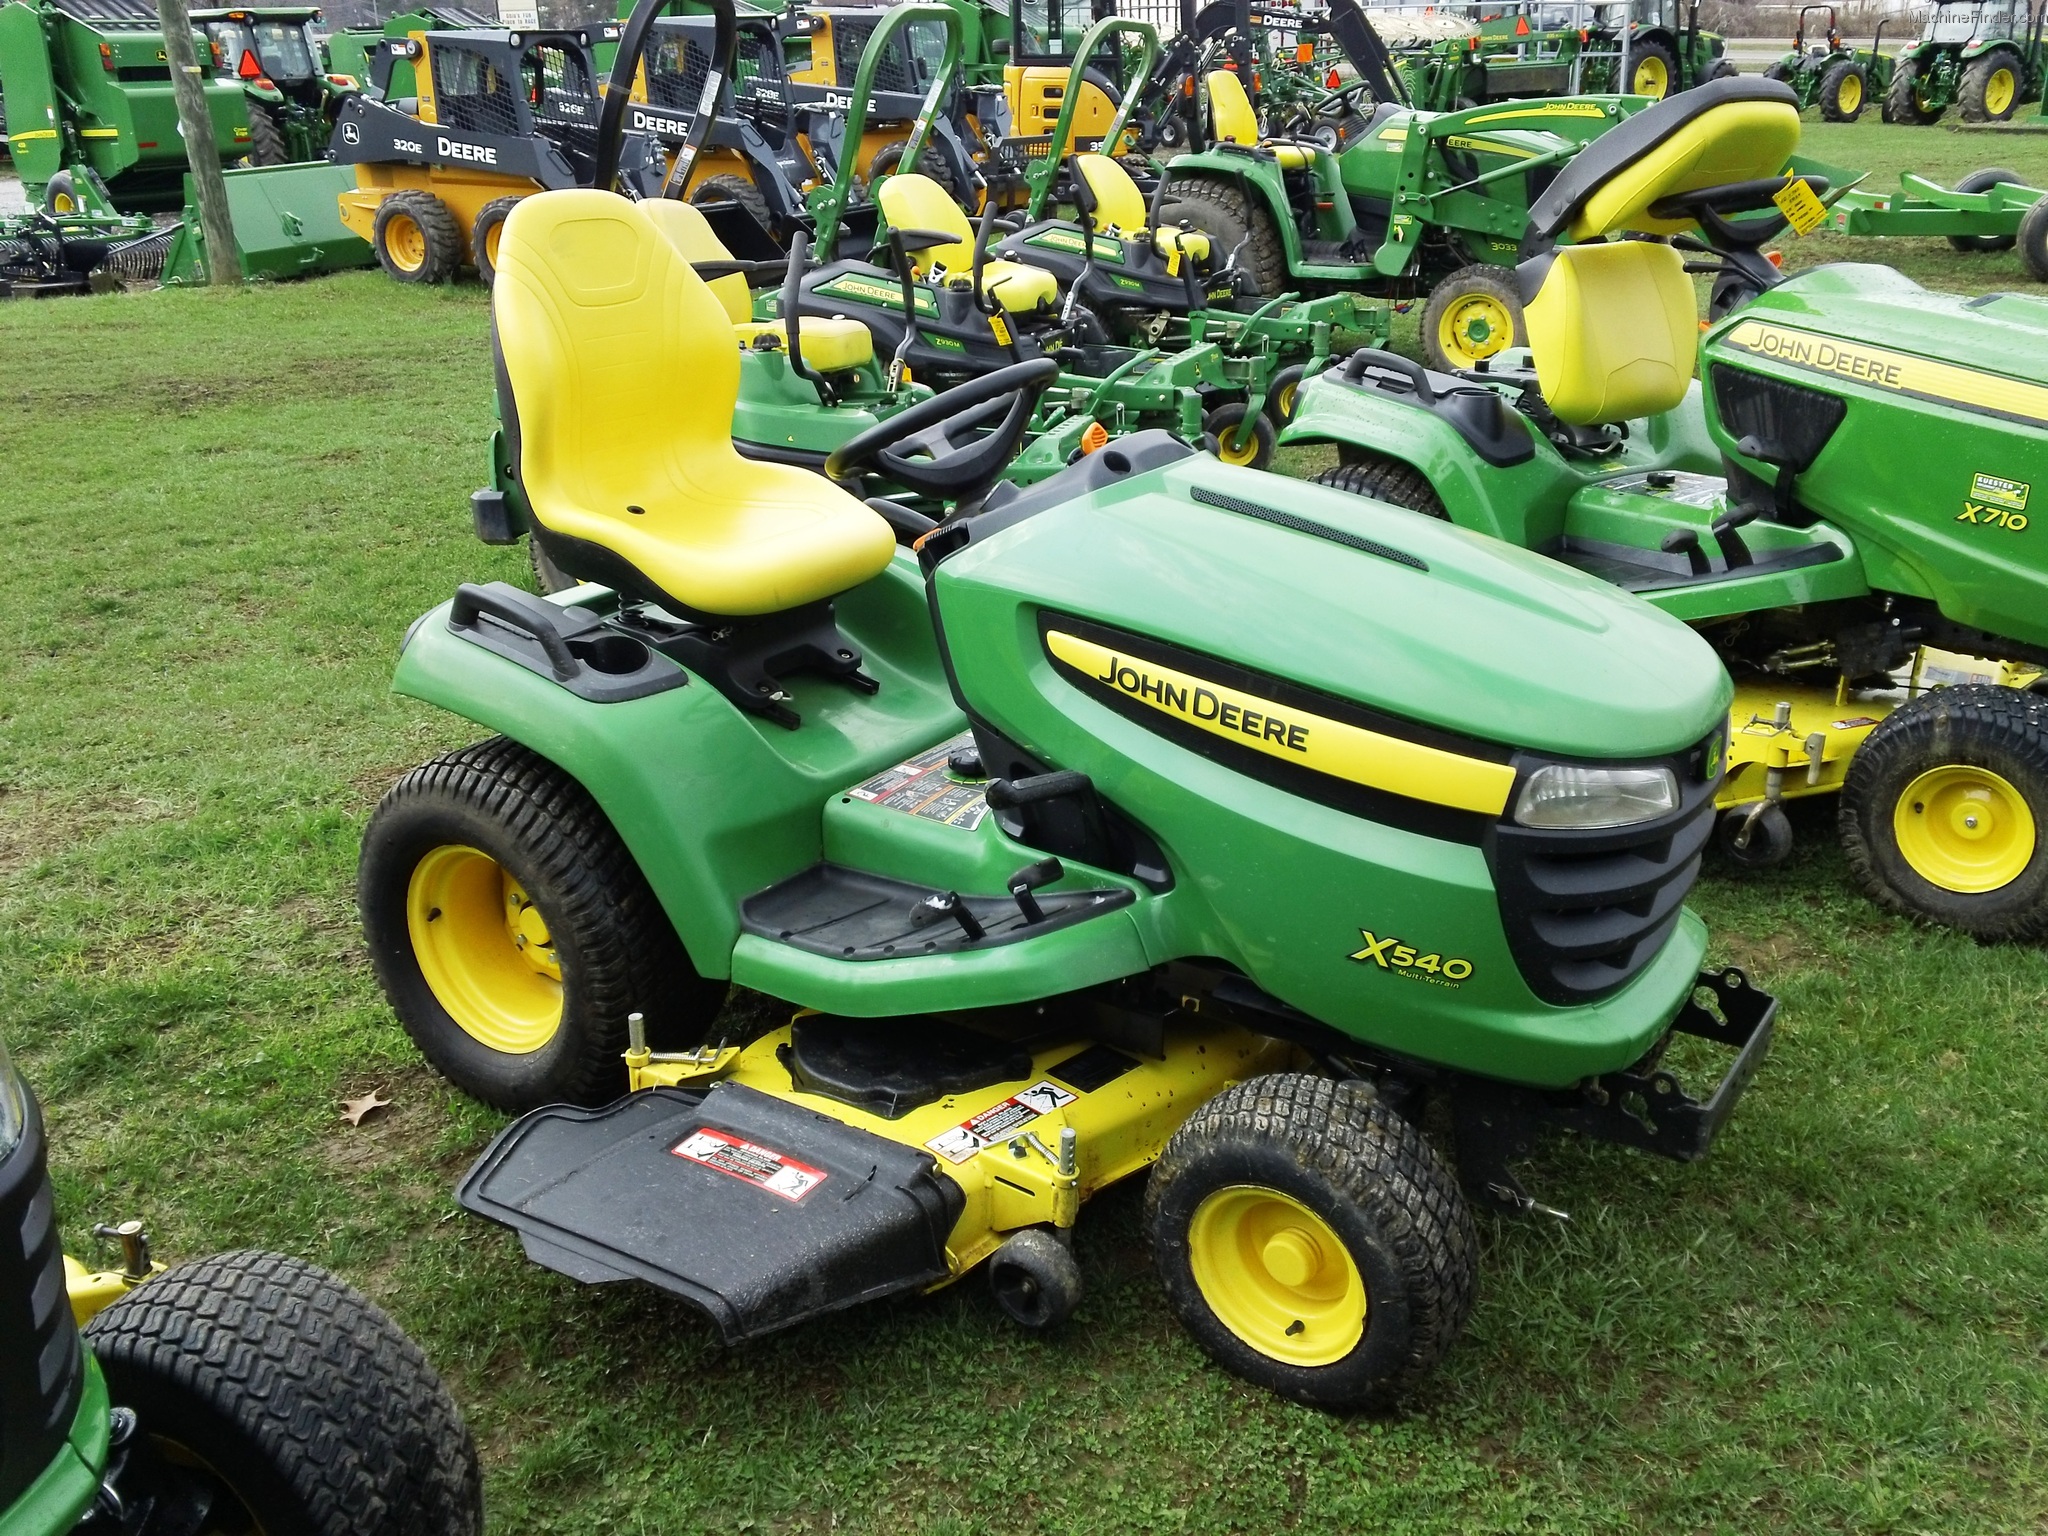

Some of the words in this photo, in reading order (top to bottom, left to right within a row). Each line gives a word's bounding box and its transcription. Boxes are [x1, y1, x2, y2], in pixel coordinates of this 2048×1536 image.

[1263, 14, 1303, 28] DEERE
[825, 91, 877, 113] DEEE
[1567, 103, 1597, 111] DEERE
[633, 111, 688, 137] DEERE
[393, 138, 423, 154] 320E
[437, 136, 497, 165] DEERE
[1449, 138, 1472, 148] EERE
[1049, 235, 1068, 245] JOHN
[842, 282, 866, 293] JOHN
[867, 286, 896, 299] DEERE
[1750, 327, 1813, 363] JOHN
[1816, 343, 1902, 386] DEERE
[1956, 501, 2029, 531] X710
[1098, 656, 1188, 713] JOHN
[1192, 686, 1310, 753] DEERE
[1348, 929, 1474, 980] X540
[1397, 969, 1460, 989] Multi-Terrain
[977, 1101, 1011, 1121] DANGER
[752, 1147, 782, 1162] DANGER
